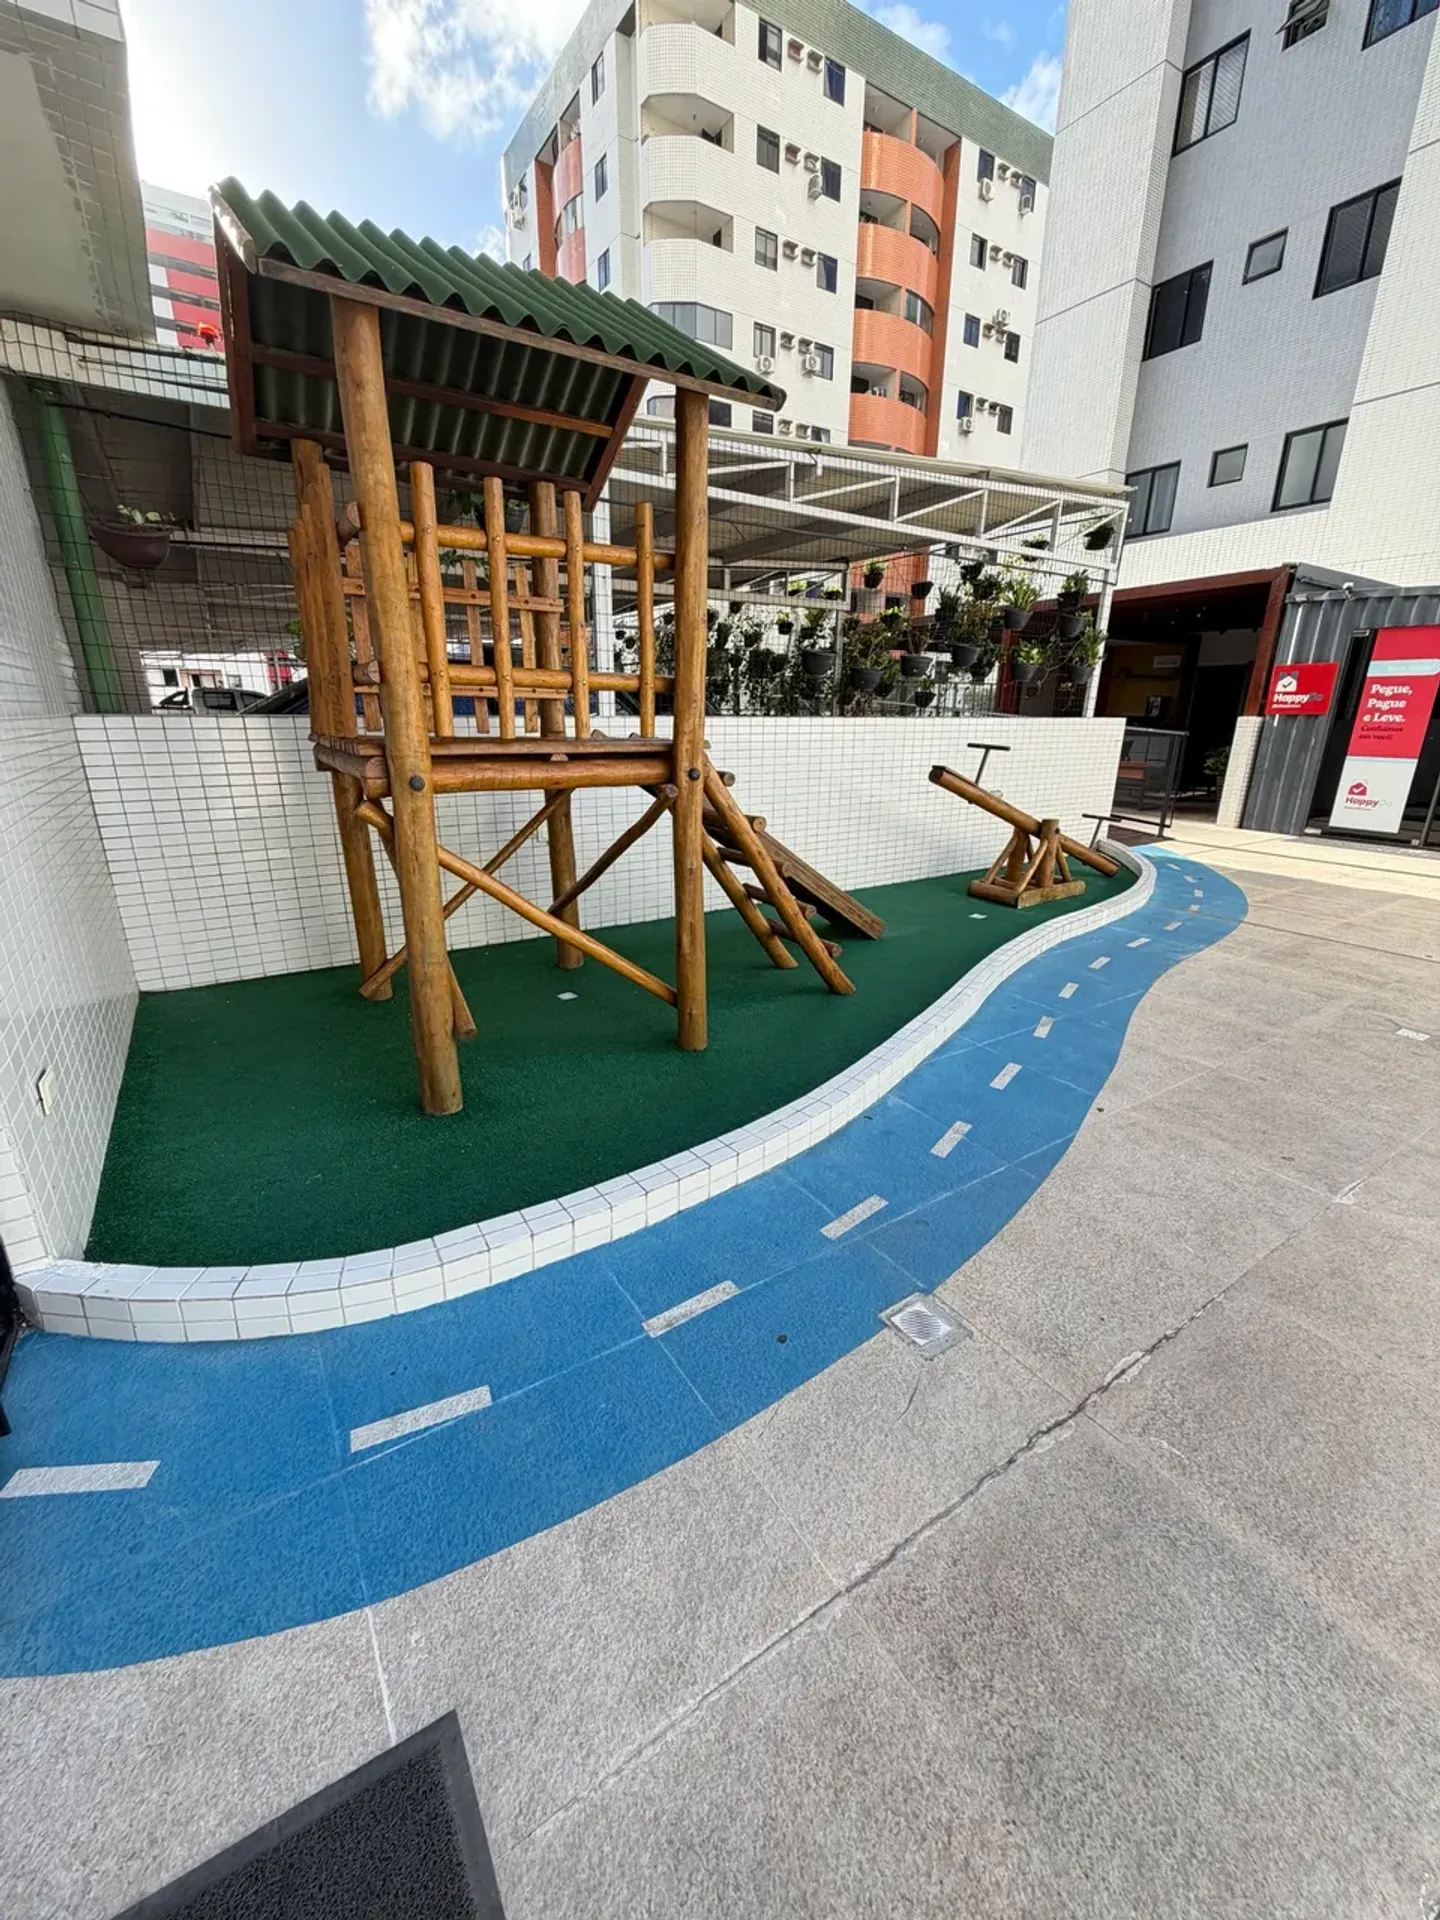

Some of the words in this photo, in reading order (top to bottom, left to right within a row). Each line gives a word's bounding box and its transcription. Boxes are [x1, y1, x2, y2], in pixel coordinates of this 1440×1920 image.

[1370, 684, 1413, 697] Pegue,
[1367, 698, 1407, 711] Pague
[1363, 714, 1371, 722] e
[1372, 712, 1406, 723] Leve.
